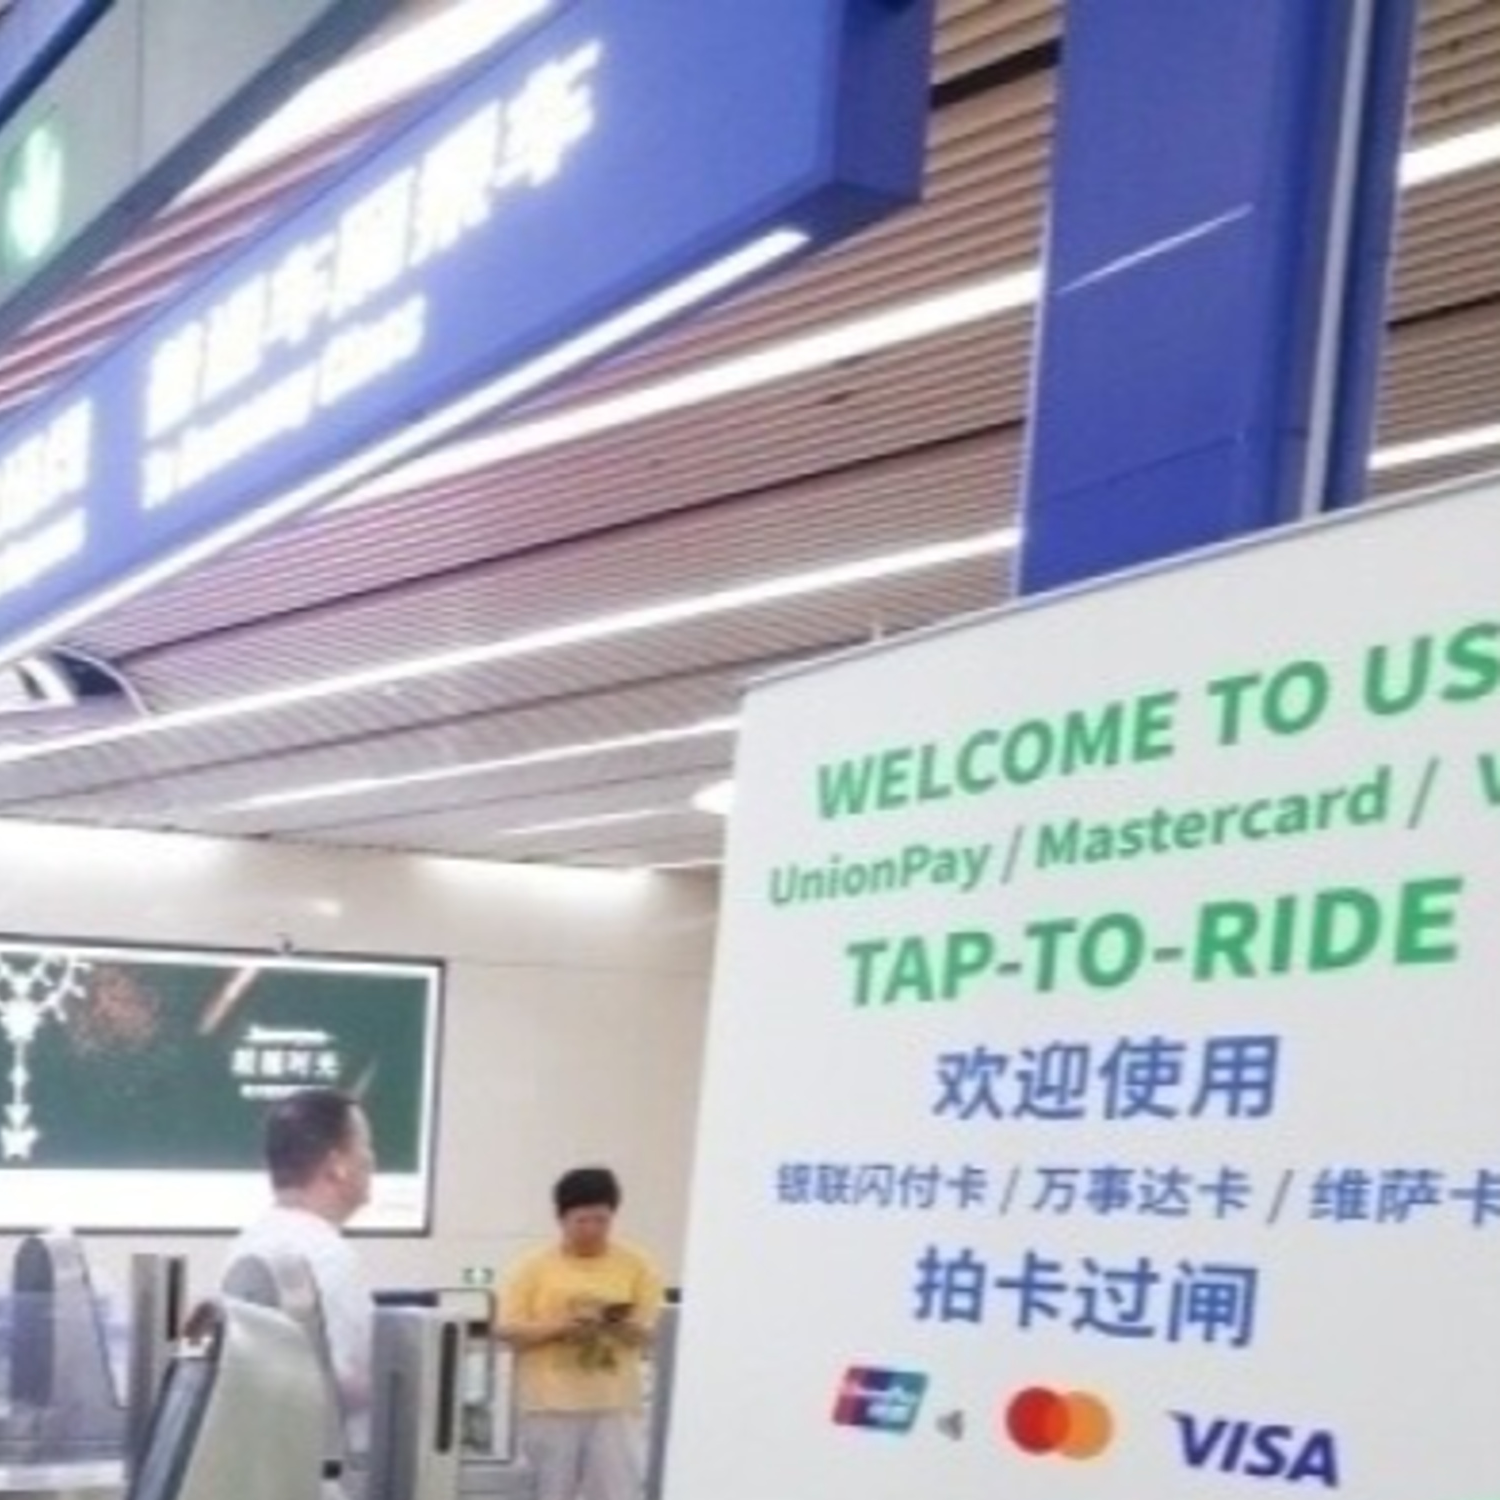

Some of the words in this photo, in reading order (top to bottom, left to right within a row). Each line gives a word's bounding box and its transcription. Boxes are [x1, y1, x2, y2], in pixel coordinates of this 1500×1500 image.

[816, 690, 1180, 820] WELCOME
[1207, 660, 1329, 746] TO
[769, 841, 993, 906] UnionPay
[1034, 764, 1392, 869] Mastercard
[846, 876, 1465, 1006] TAP-TO-RIDE
[932, 1034, 1281, 1122] 欢迎使用
[775, 1162, 988, 1210] 银联闪付卡
[1031, 1165, 1253, 1221] 万事达卡
[1308, 1167, 1500, 1229] 维萨卡
[912, 1245, 1260, 1349] 拍卡过闸
[1169, 1409, 1342, 1488] VISA
